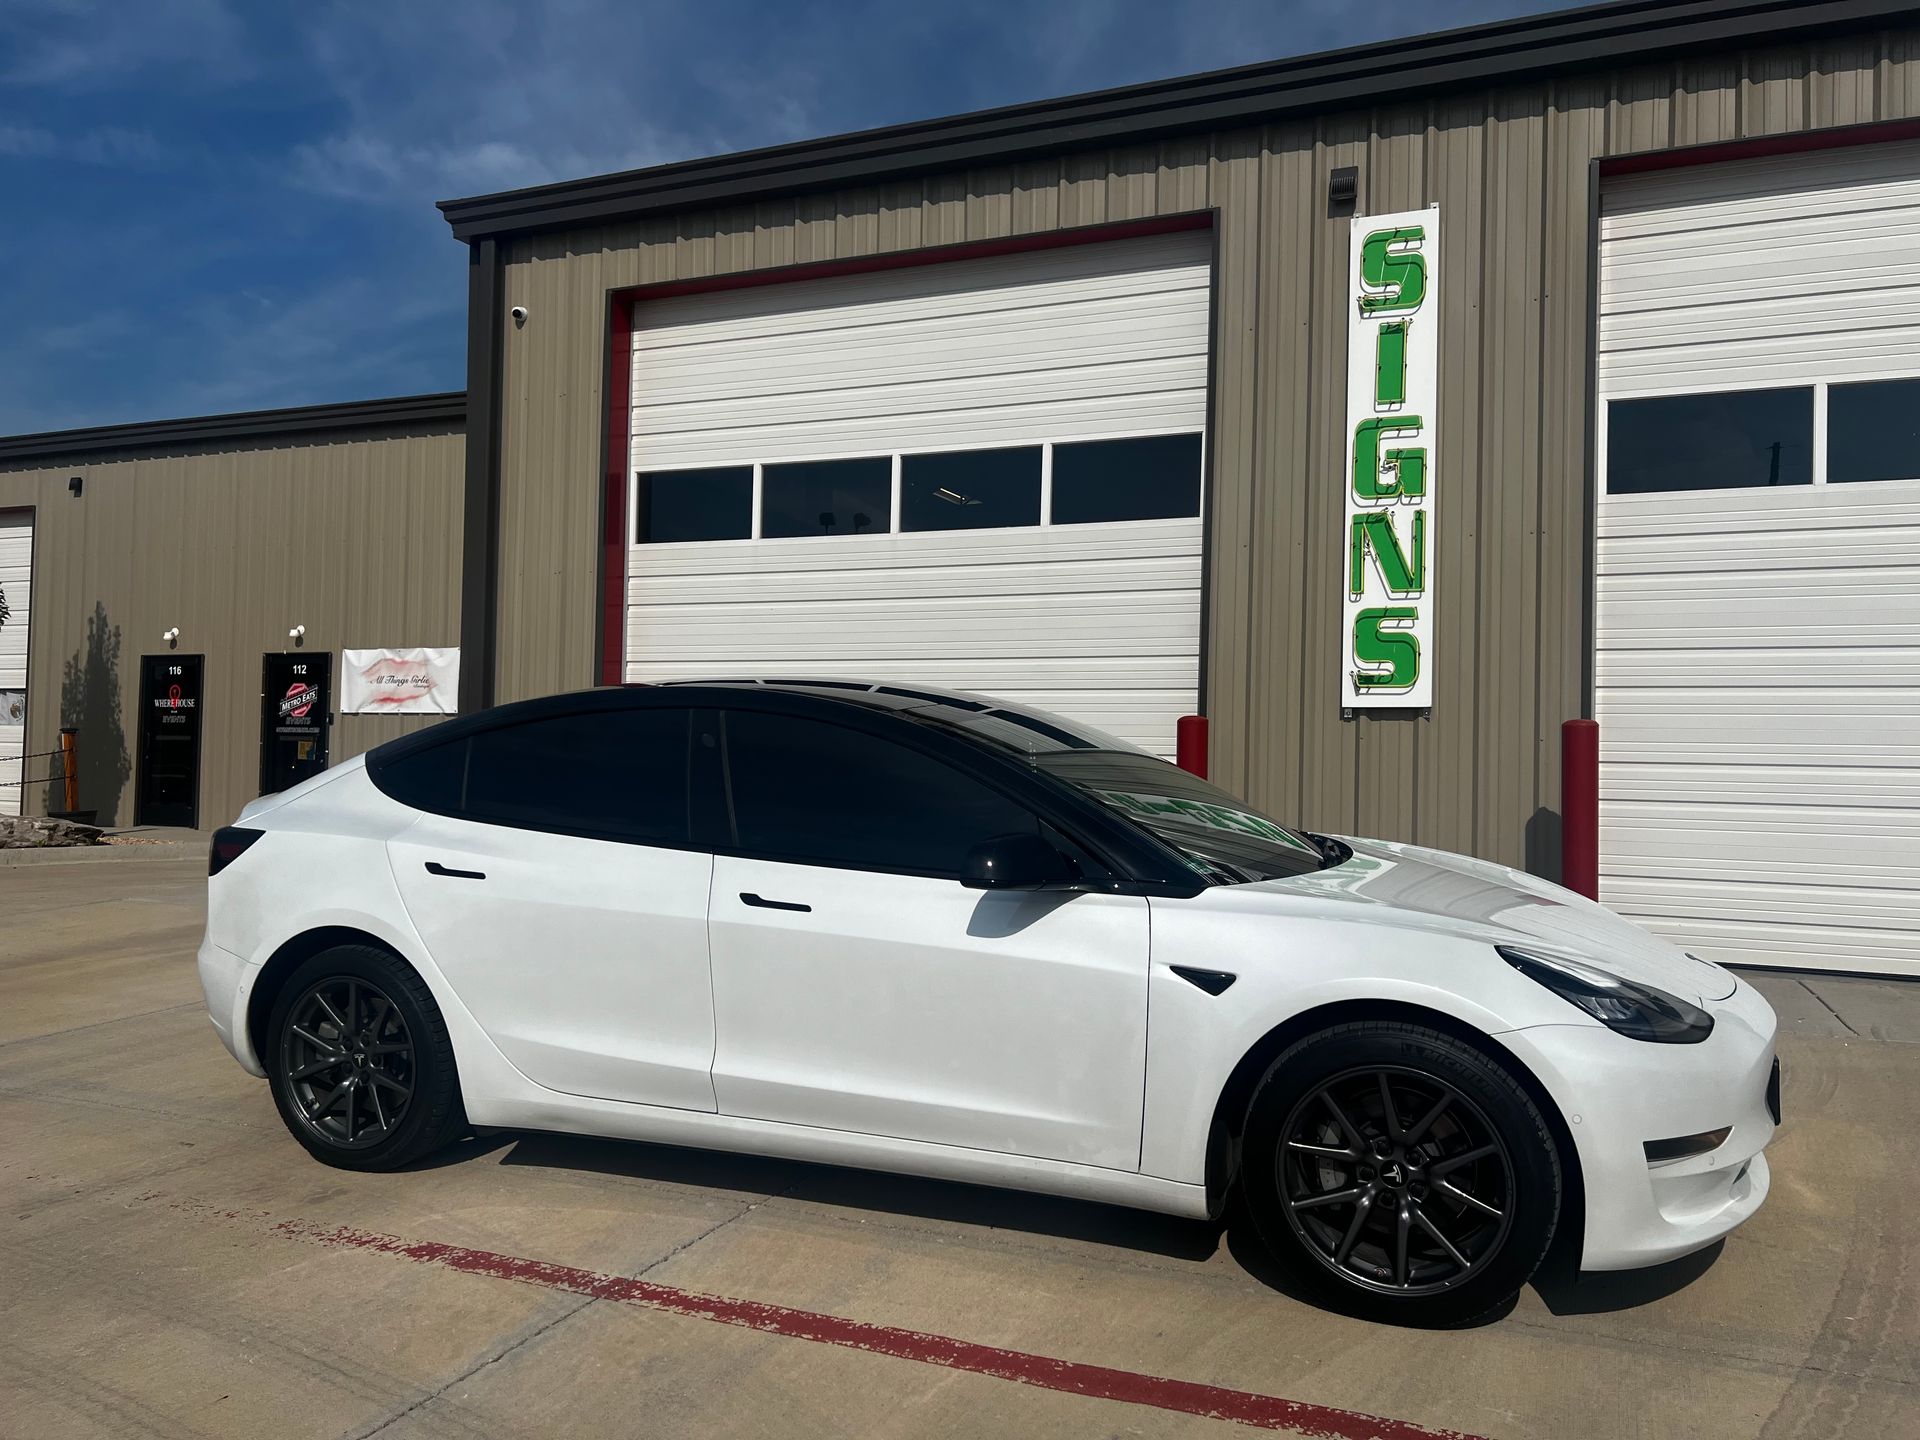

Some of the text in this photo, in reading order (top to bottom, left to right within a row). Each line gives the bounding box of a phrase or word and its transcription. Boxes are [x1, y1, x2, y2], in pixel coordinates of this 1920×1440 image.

[1350, 225, 1428, 690] SIGNS
[168, 666, 182, 675] 116
[293, 664, 307, 674] 112
[370, 675, 384, 685] All
[385, 675, 409, 687] Things
[281, 690, 316, 711] METRO EATS
